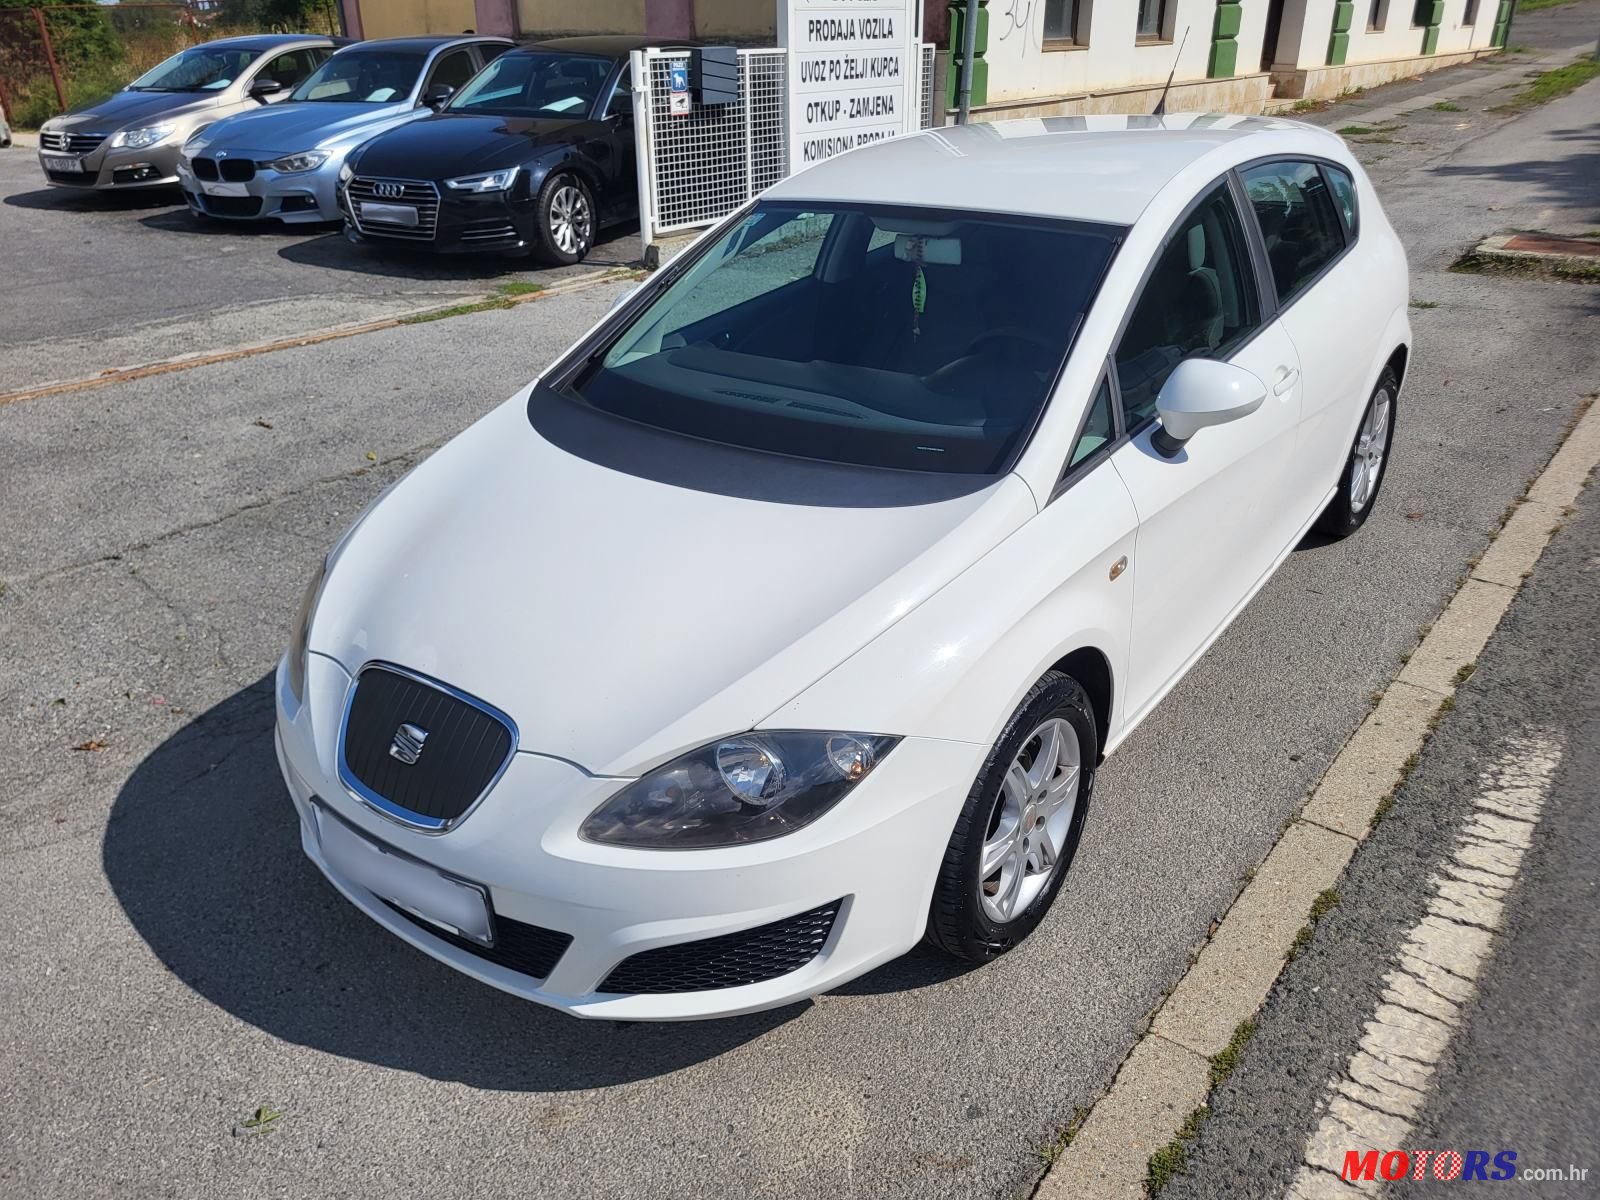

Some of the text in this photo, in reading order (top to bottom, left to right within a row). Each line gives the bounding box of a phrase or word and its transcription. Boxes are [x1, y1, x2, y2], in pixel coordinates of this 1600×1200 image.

[808, 17, 894, 42] PRODAJA VOZILA
[801, 54, 899, 83] UVOZ PO ŽELJI KUPCA
[806, 99, 841, 124] OTKUP
[849, 95, 894, 119] ZAMJENA
[803, 135, 854, 162] KOMISIONA
